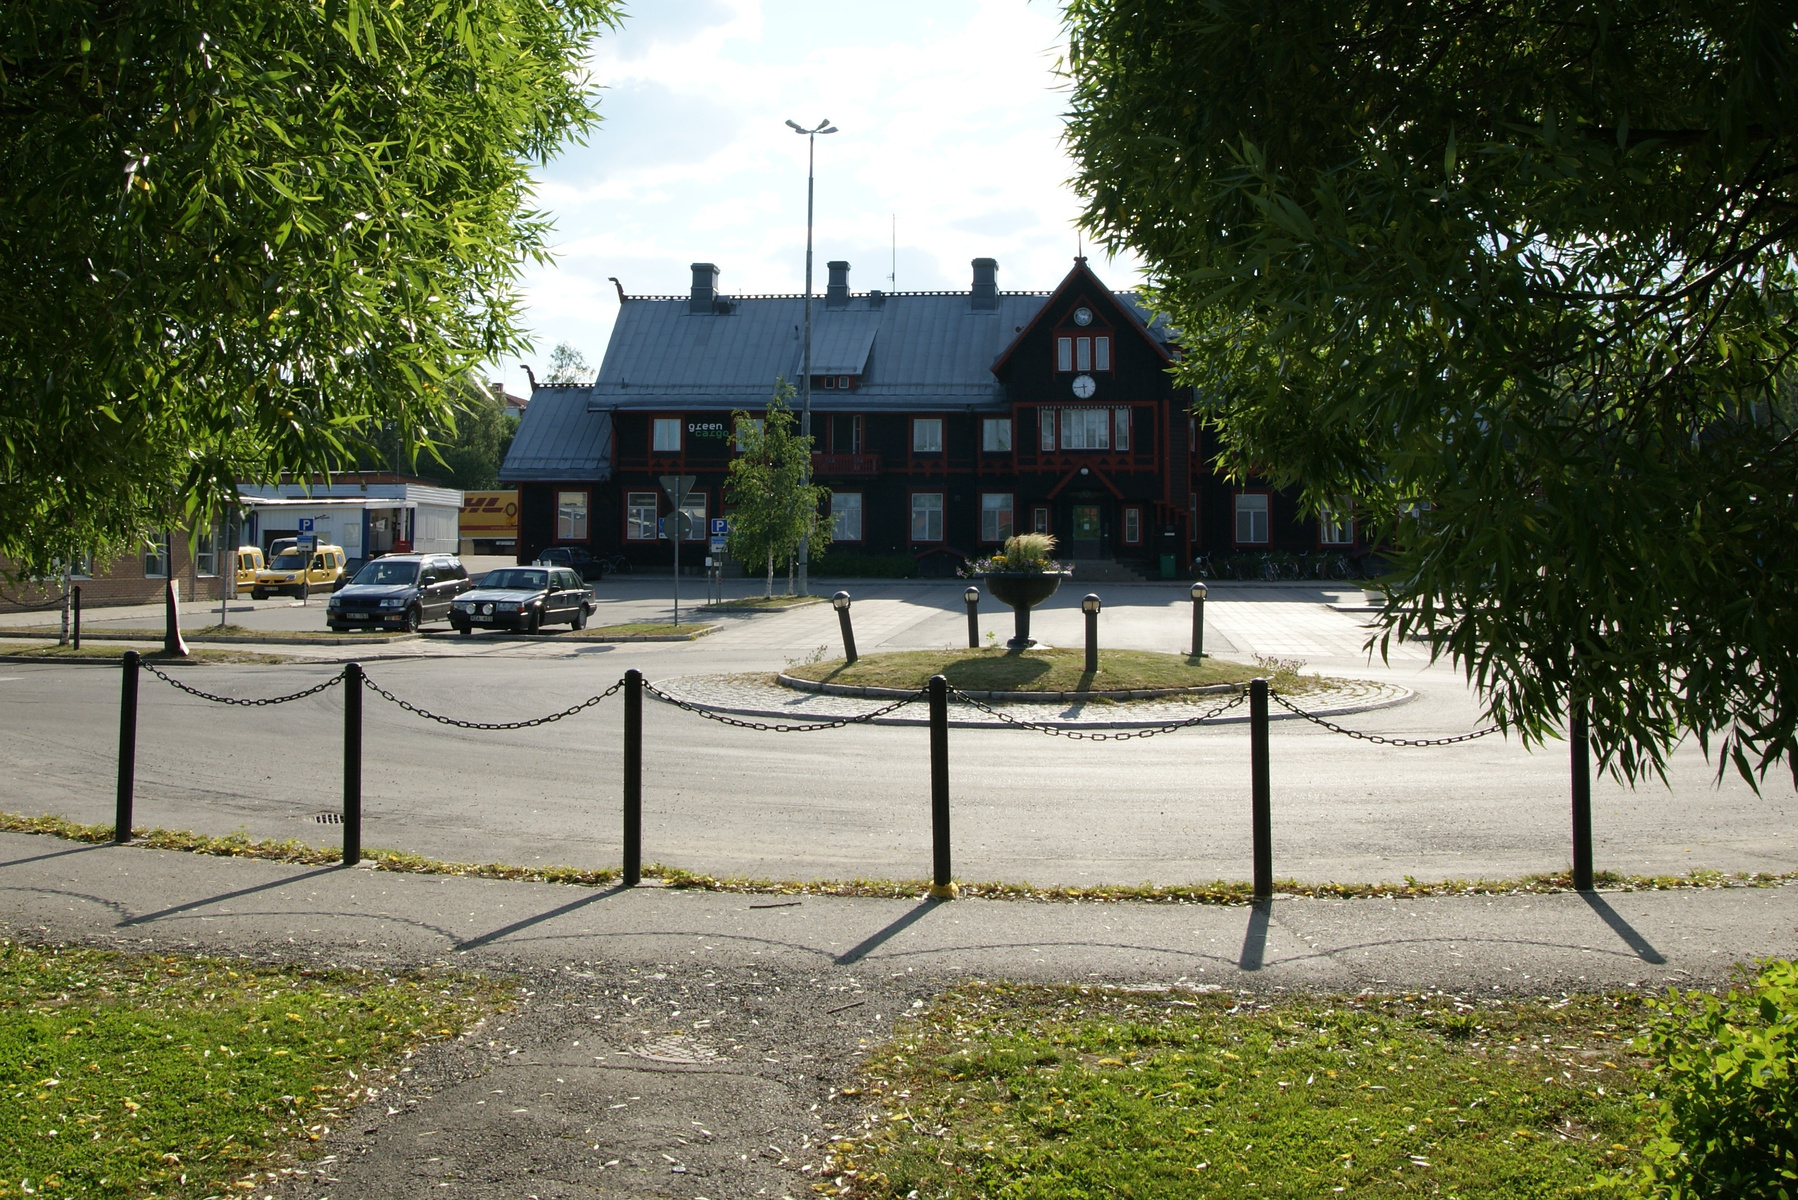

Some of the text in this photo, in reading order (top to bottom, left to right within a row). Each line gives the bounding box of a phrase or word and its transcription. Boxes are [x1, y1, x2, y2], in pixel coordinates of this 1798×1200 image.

[688, 423, 722, 432] green
[695, 430, 729, 438] cargo
[458, 497, 504, 513] HL
[716, 520, 724, 531] P
